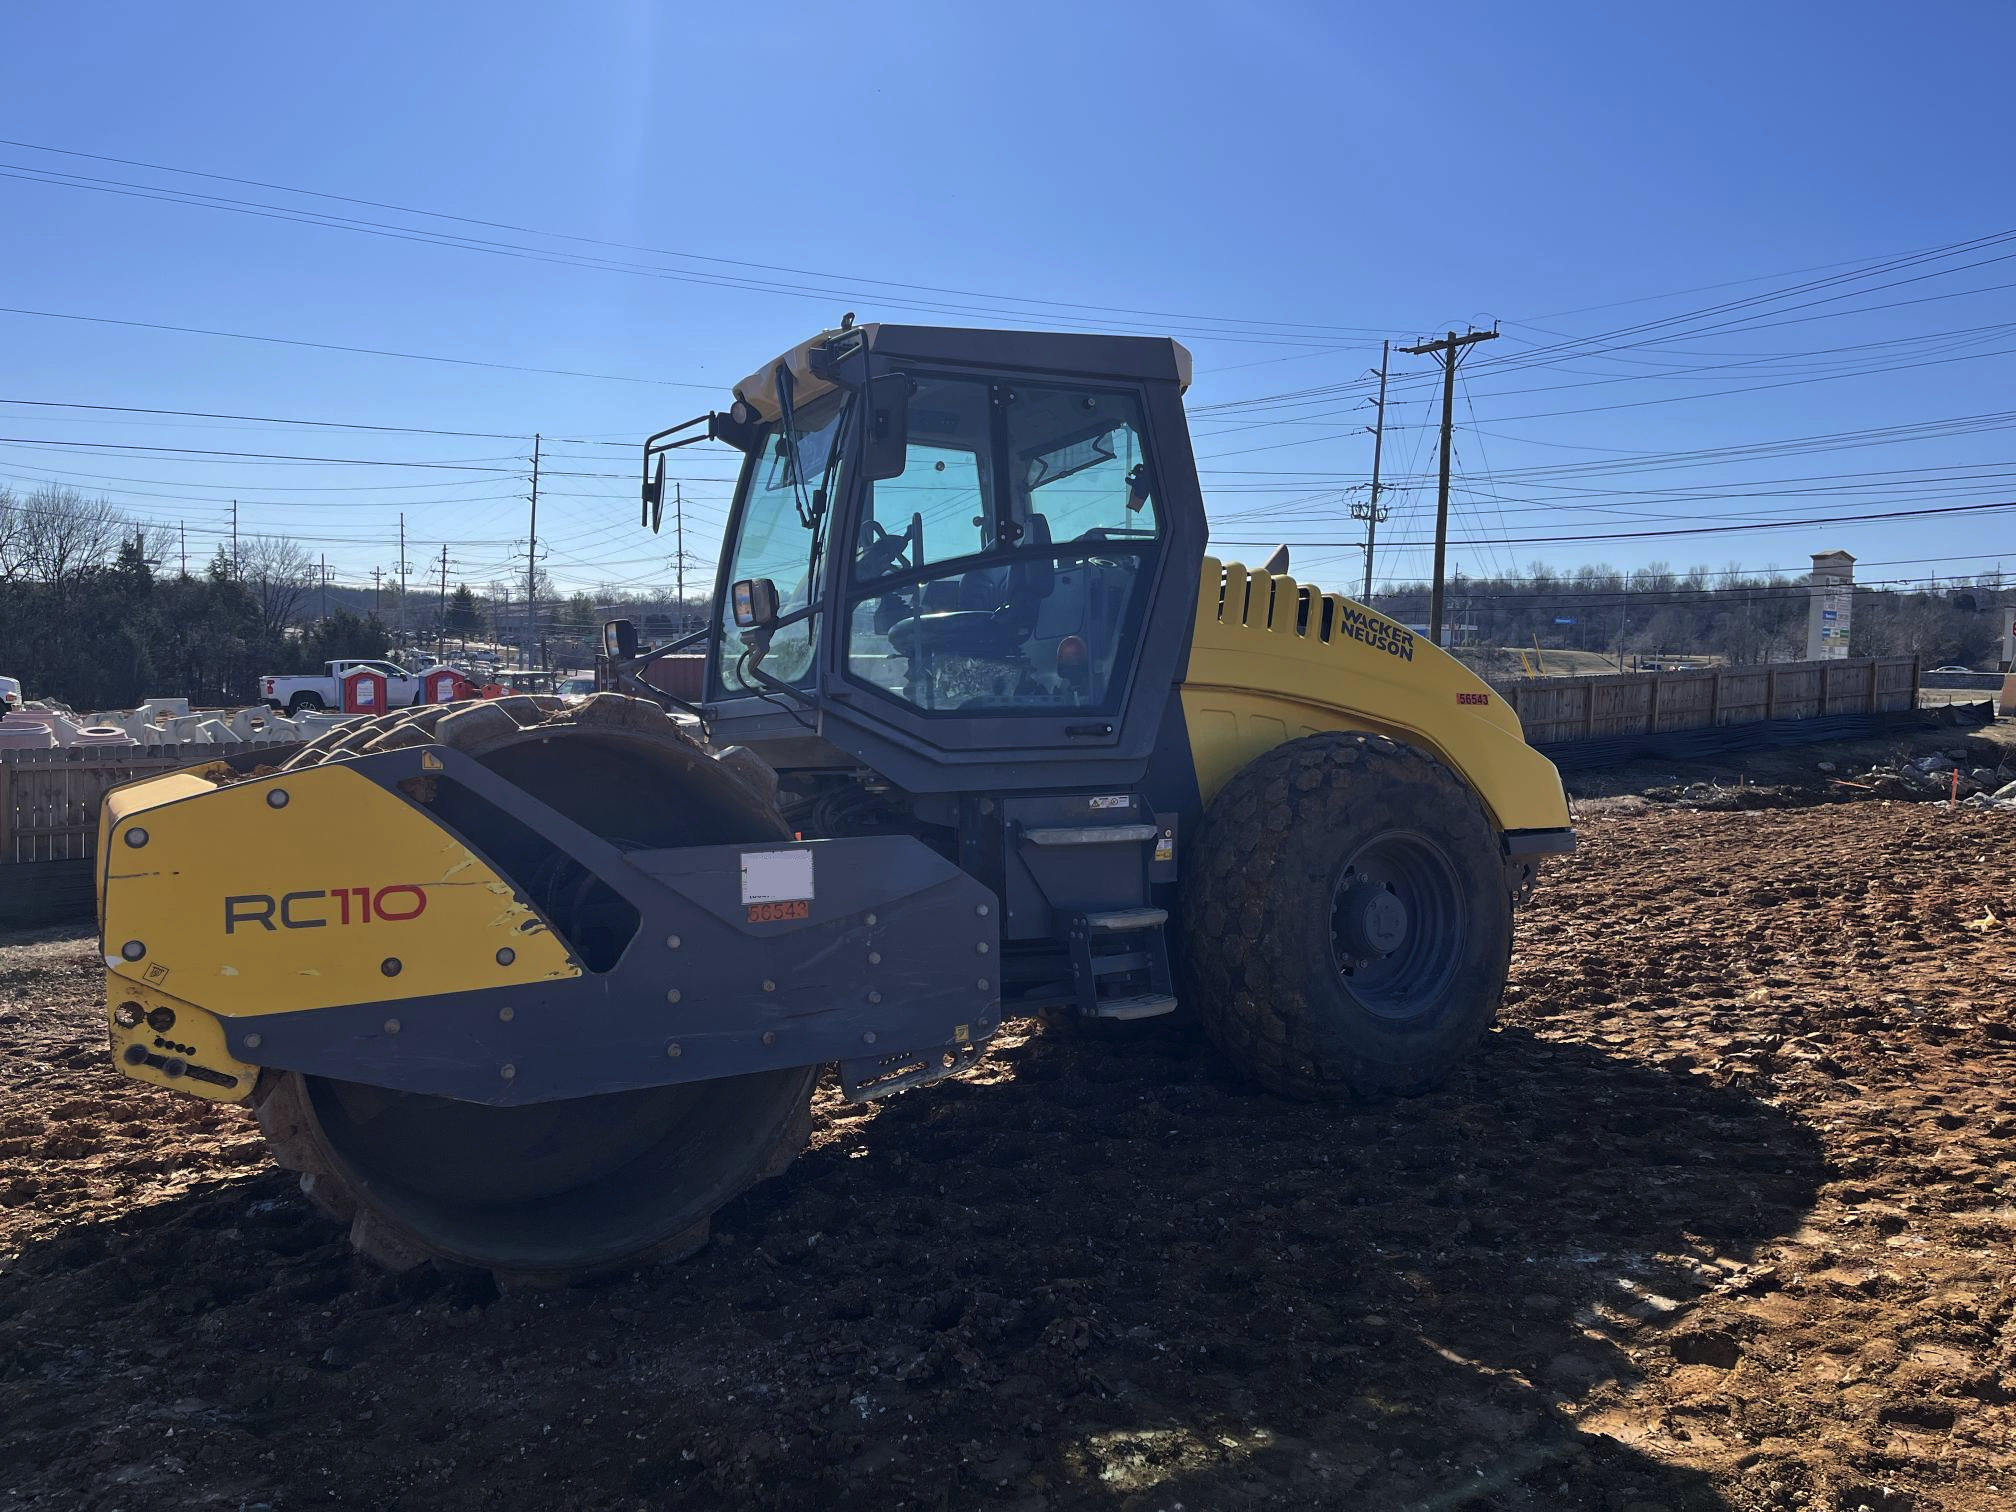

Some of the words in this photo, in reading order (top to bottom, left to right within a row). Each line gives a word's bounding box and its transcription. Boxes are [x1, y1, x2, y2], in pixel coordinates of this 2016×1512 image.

[1341, 621, 1414, 662] NEUSON
[1342, 606, 1414, 648] WACKER
[1459, 693, 1489, 705] 56543
[225, 885, 427, 934] RC110
[749, 901, 807, 921] 56543
